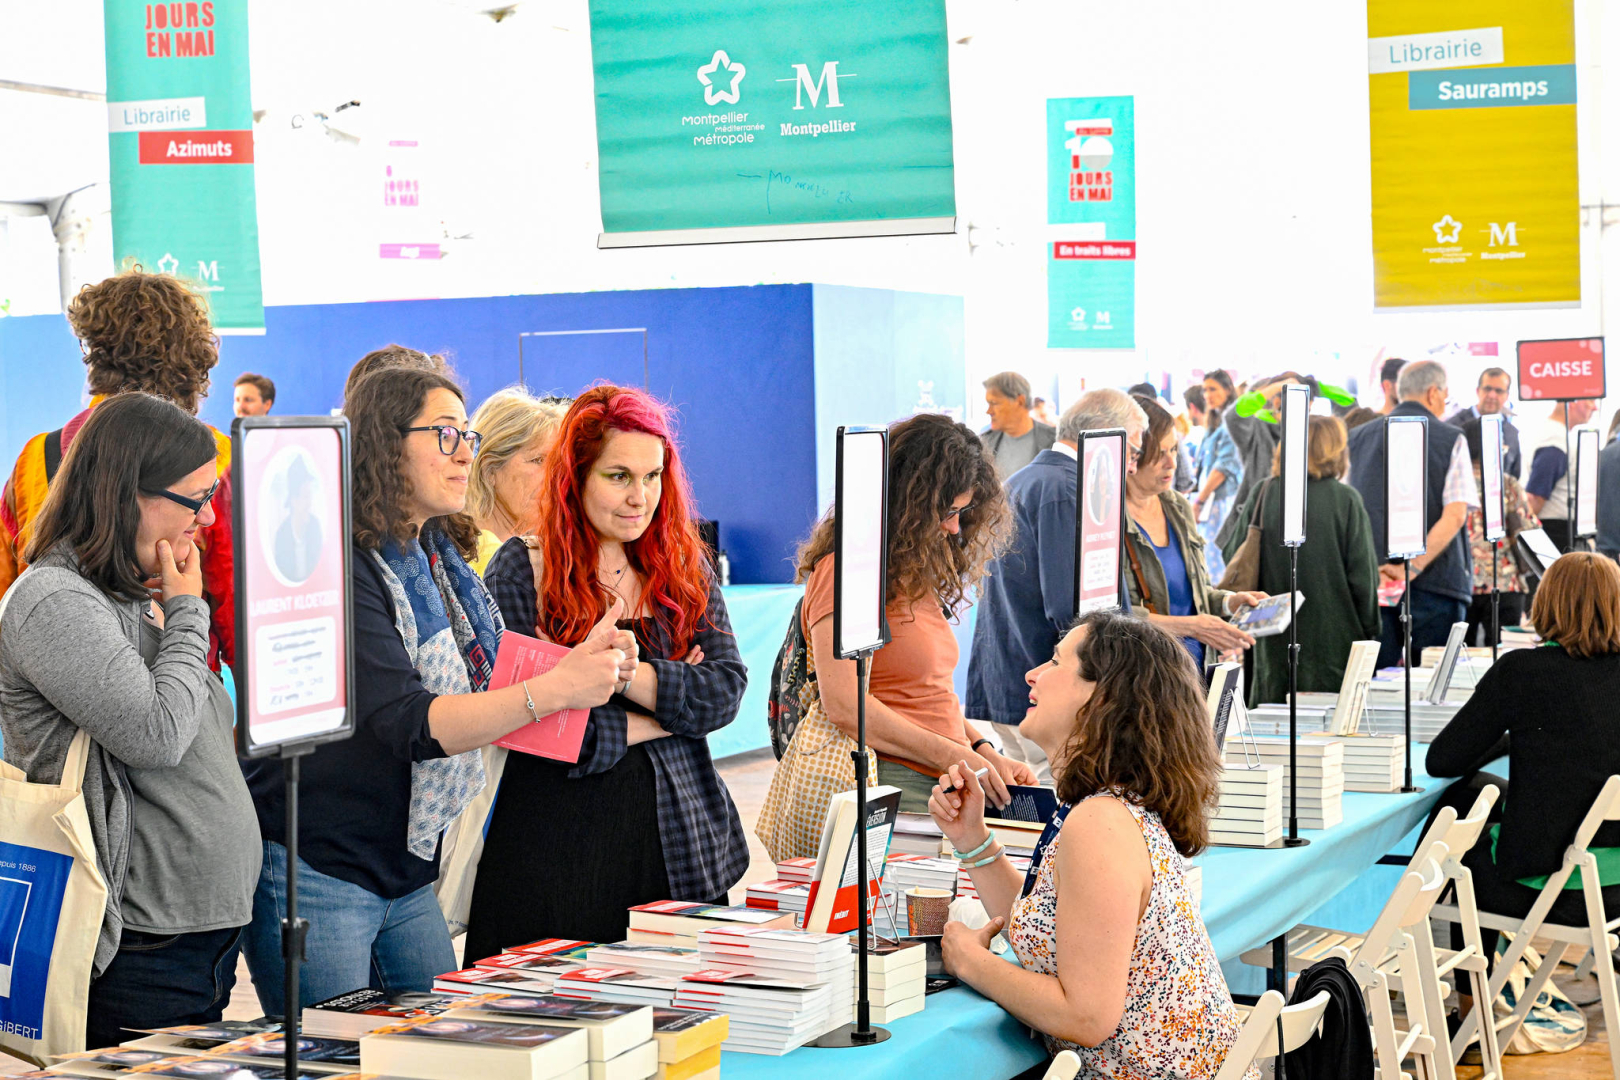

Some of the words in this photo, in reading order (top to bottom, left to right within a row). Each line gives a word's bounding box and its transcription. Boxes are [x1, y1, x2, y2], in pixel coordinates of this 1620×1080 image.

[145, 2, 215, 30] JOURS
[146, 32, 171, 57] EN
[175, 30, 215, 57] MAI
[1389, 39, 1482, 63] Librairie
[1438, 81, 1549, 101] Sauramps
[123, 106, 191, 125] Librairie
[780, 120, 856, 137] Montpellier
[166, 140, 232, 157] Azimuts
[1070, 171, 1113, 186] JOURS
[1529, 360, 1593, 378] CAISSE
[18, 862, 37, 873] 1886
